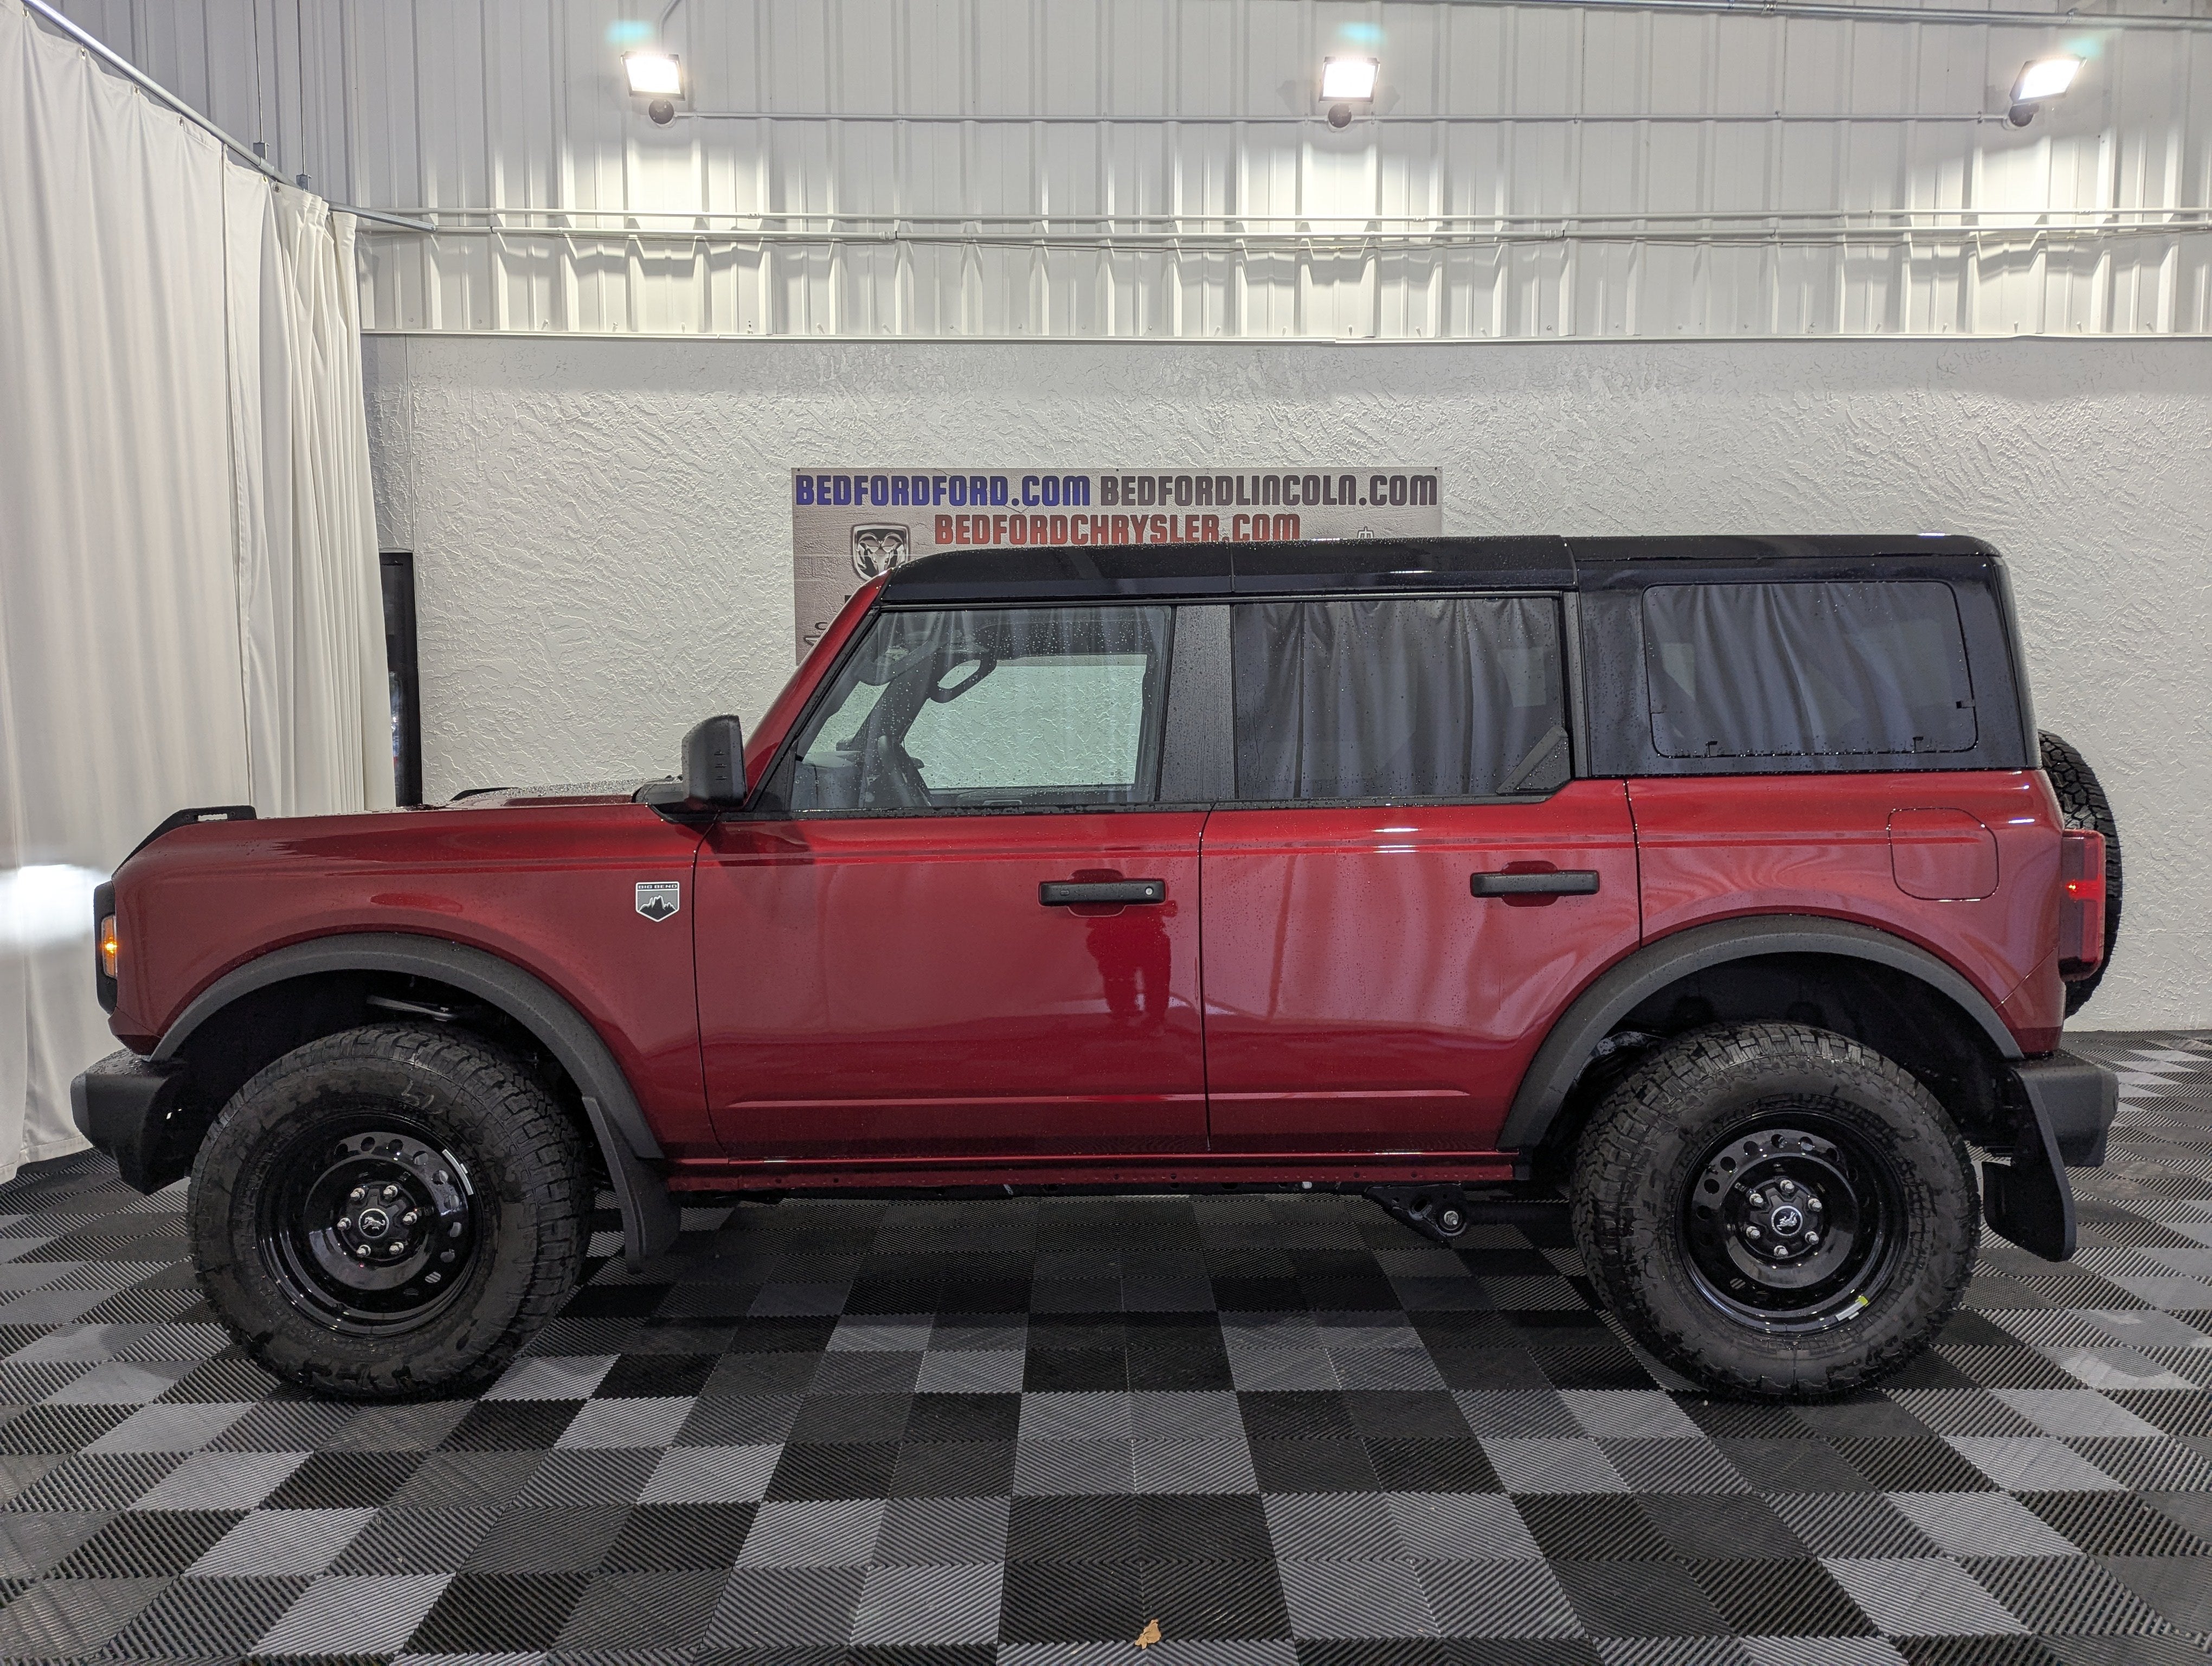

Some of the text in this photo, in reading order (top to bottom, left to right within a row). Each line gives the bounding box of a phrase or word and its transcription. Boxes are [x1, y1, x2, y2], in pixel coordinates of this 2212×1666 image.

[796, 475, 1438, 506] BEDFORDFORD.COM BEDFORDLINCOLN.COM
[935, 514, 1301, 544] BEDFORDCHRYSLER.COM
